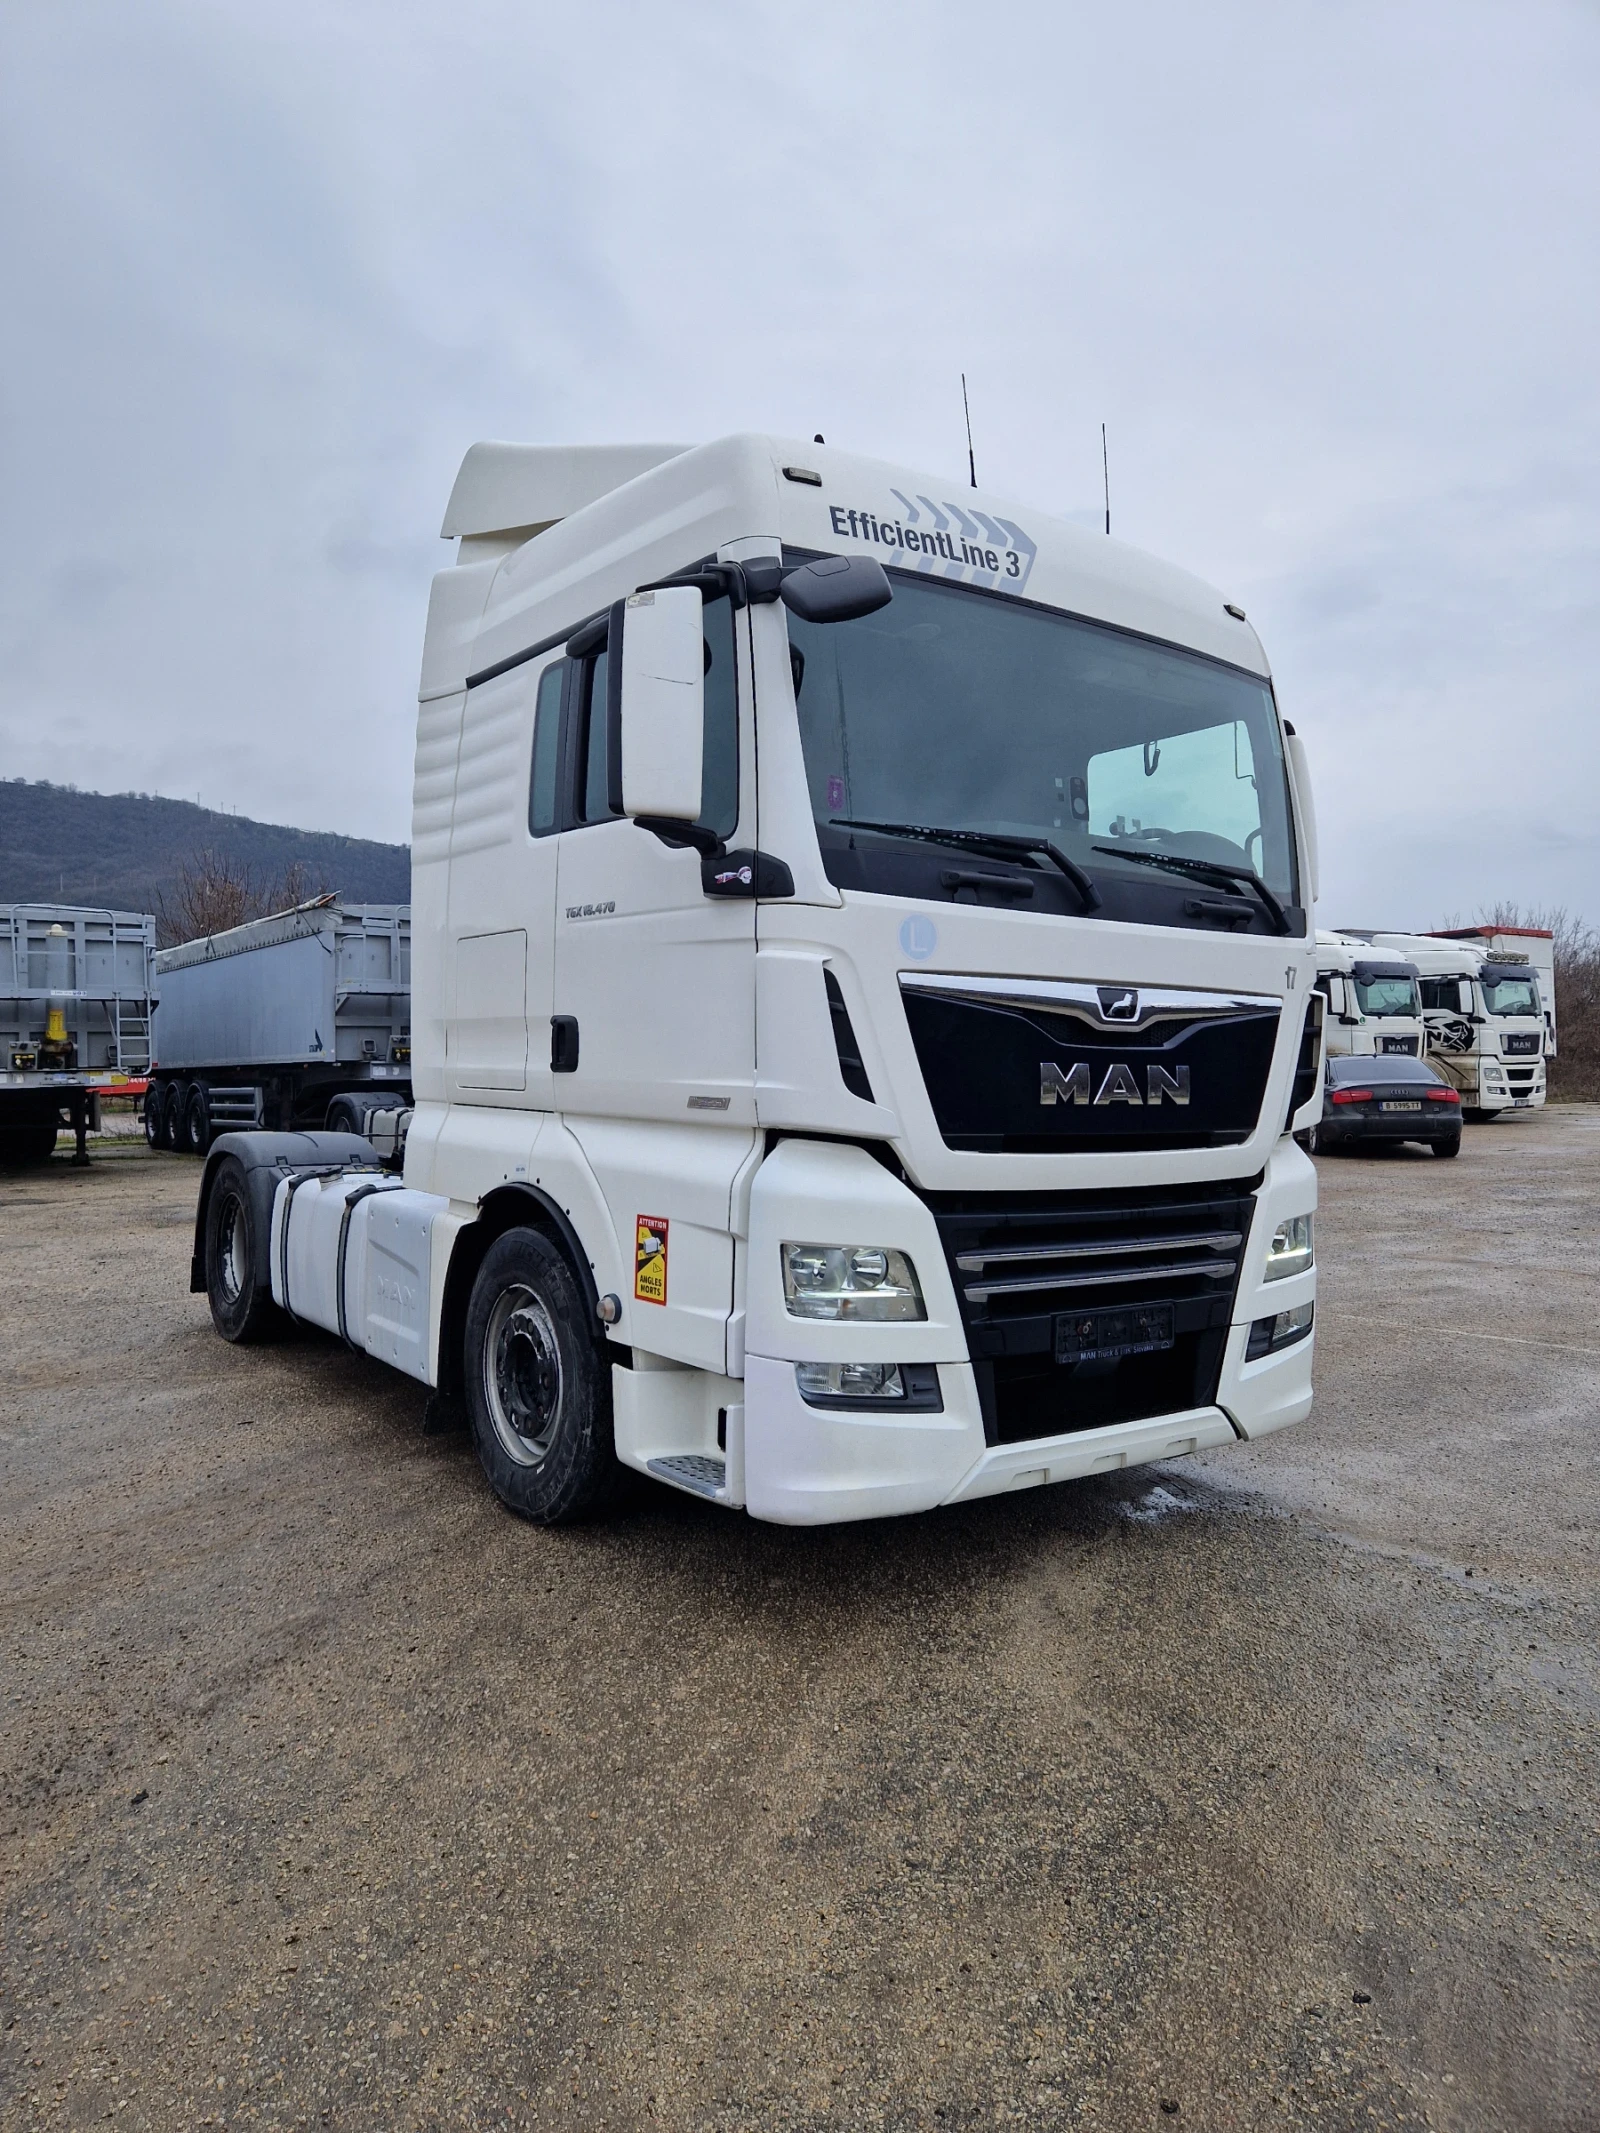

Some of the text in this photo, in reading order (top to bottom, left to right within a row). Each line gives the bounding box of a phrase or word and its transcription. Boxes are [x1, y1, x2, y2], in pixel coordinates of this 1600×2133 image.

[829, 505, 1020, 578] EfficientLine 3
[565, 906, 582, 919] TGX
[1285, 965, 1297, 990] 17
[1388, 1044, 1409, 1053] MAN
[1512, 1041, 1531, 1049] MAN
[1040, 1062, 1190, 1105] MAN
[639, 1217, 667, 1229] ATTENTION
[640, 1274, 662, 1287] ANGLES
[640, 1284, 661, 1296] MORTS
[1080, 1351, 1096, 1361] MAN
[1097, 1348, 1113, 1358] Truck
[1133, 1344, 1154, 1353] Slovakia
